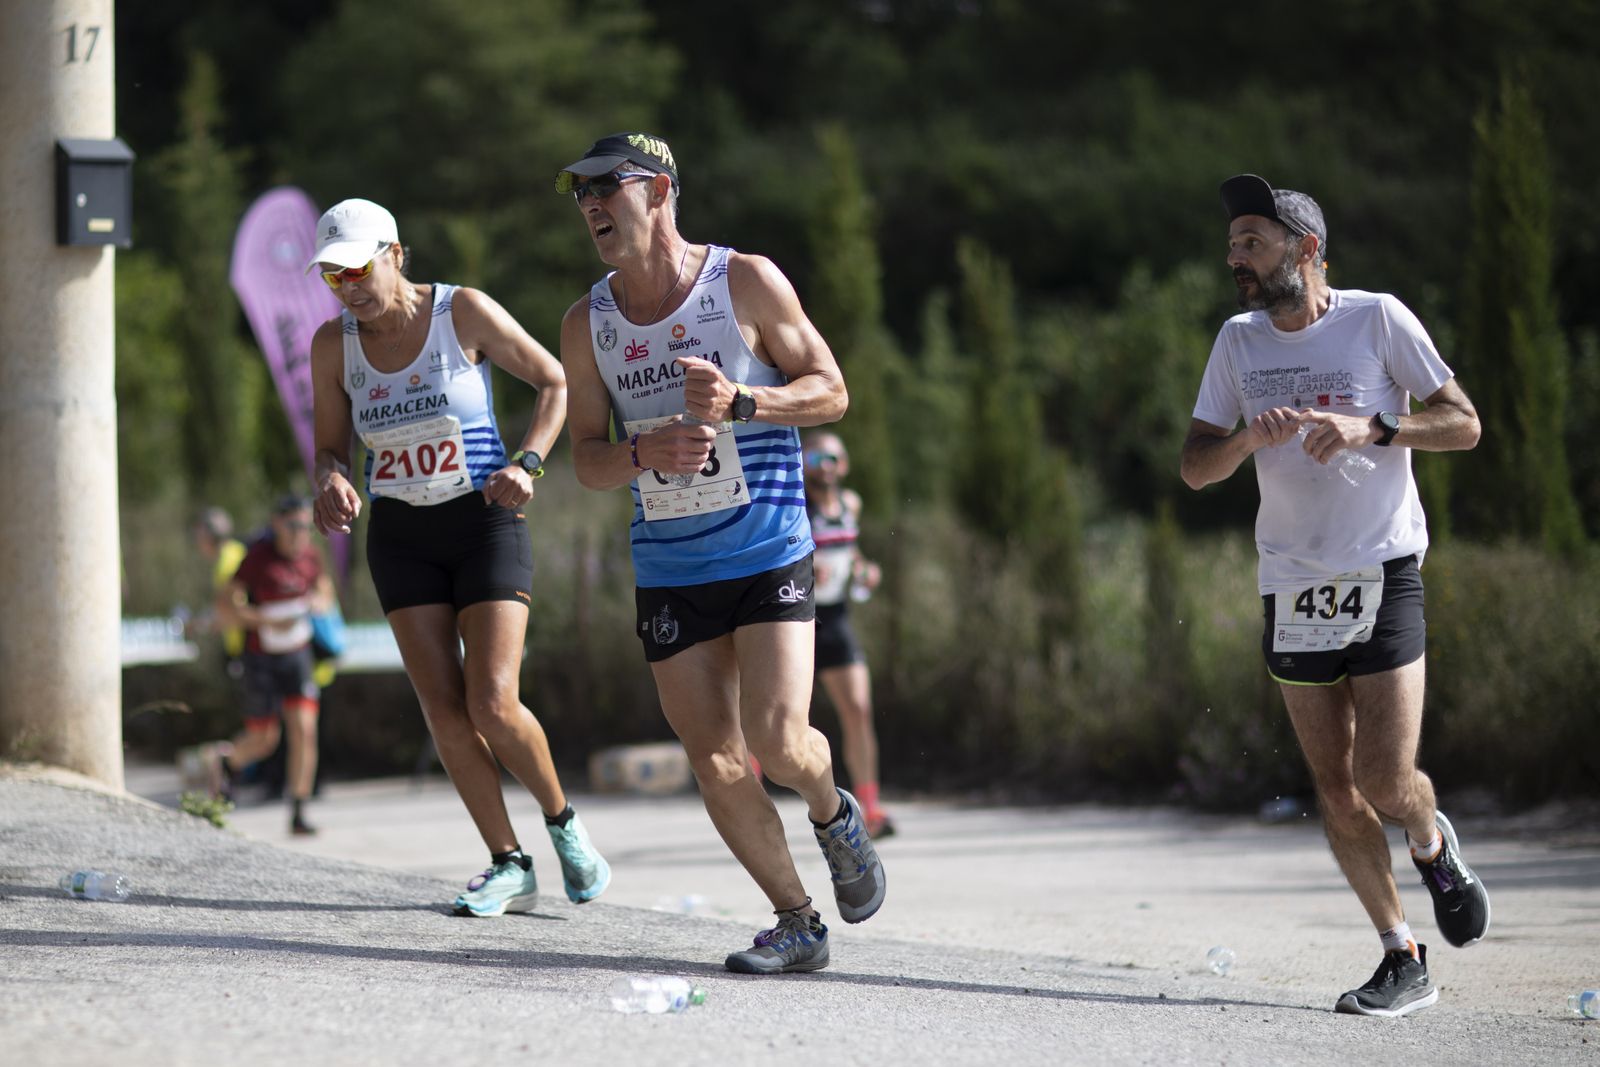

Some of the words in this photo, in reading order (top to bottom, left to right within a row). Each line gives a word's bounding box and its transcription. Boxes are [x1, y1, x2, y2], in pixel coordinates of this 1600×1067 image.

[64, 22, 101, 65] 17
[668, 338, 701, 352] mayfo
[617, 350, 724, 391] MARACA
[1259, 366, 1310, 377] TotalEnergies
[1259, 374, 1295, 388] Media
[1300, 369, 1353, 384] maratón
[406, 384, 432, 395] mayfo
[632, 390, 651, 399] CLUB
[653, 386, 665, 394] DE
[1281, 385, 1295, 396] DE
[1297, 382, 1353, 394] GRANADA
[359, 393, 450, 424] MARACENA
[369, 421, 386, 430] CLUB
[388, 418, 396, 426] DE
[375, 440, 460, 480] 2102
[1294, 585, 1363, 620] 434
